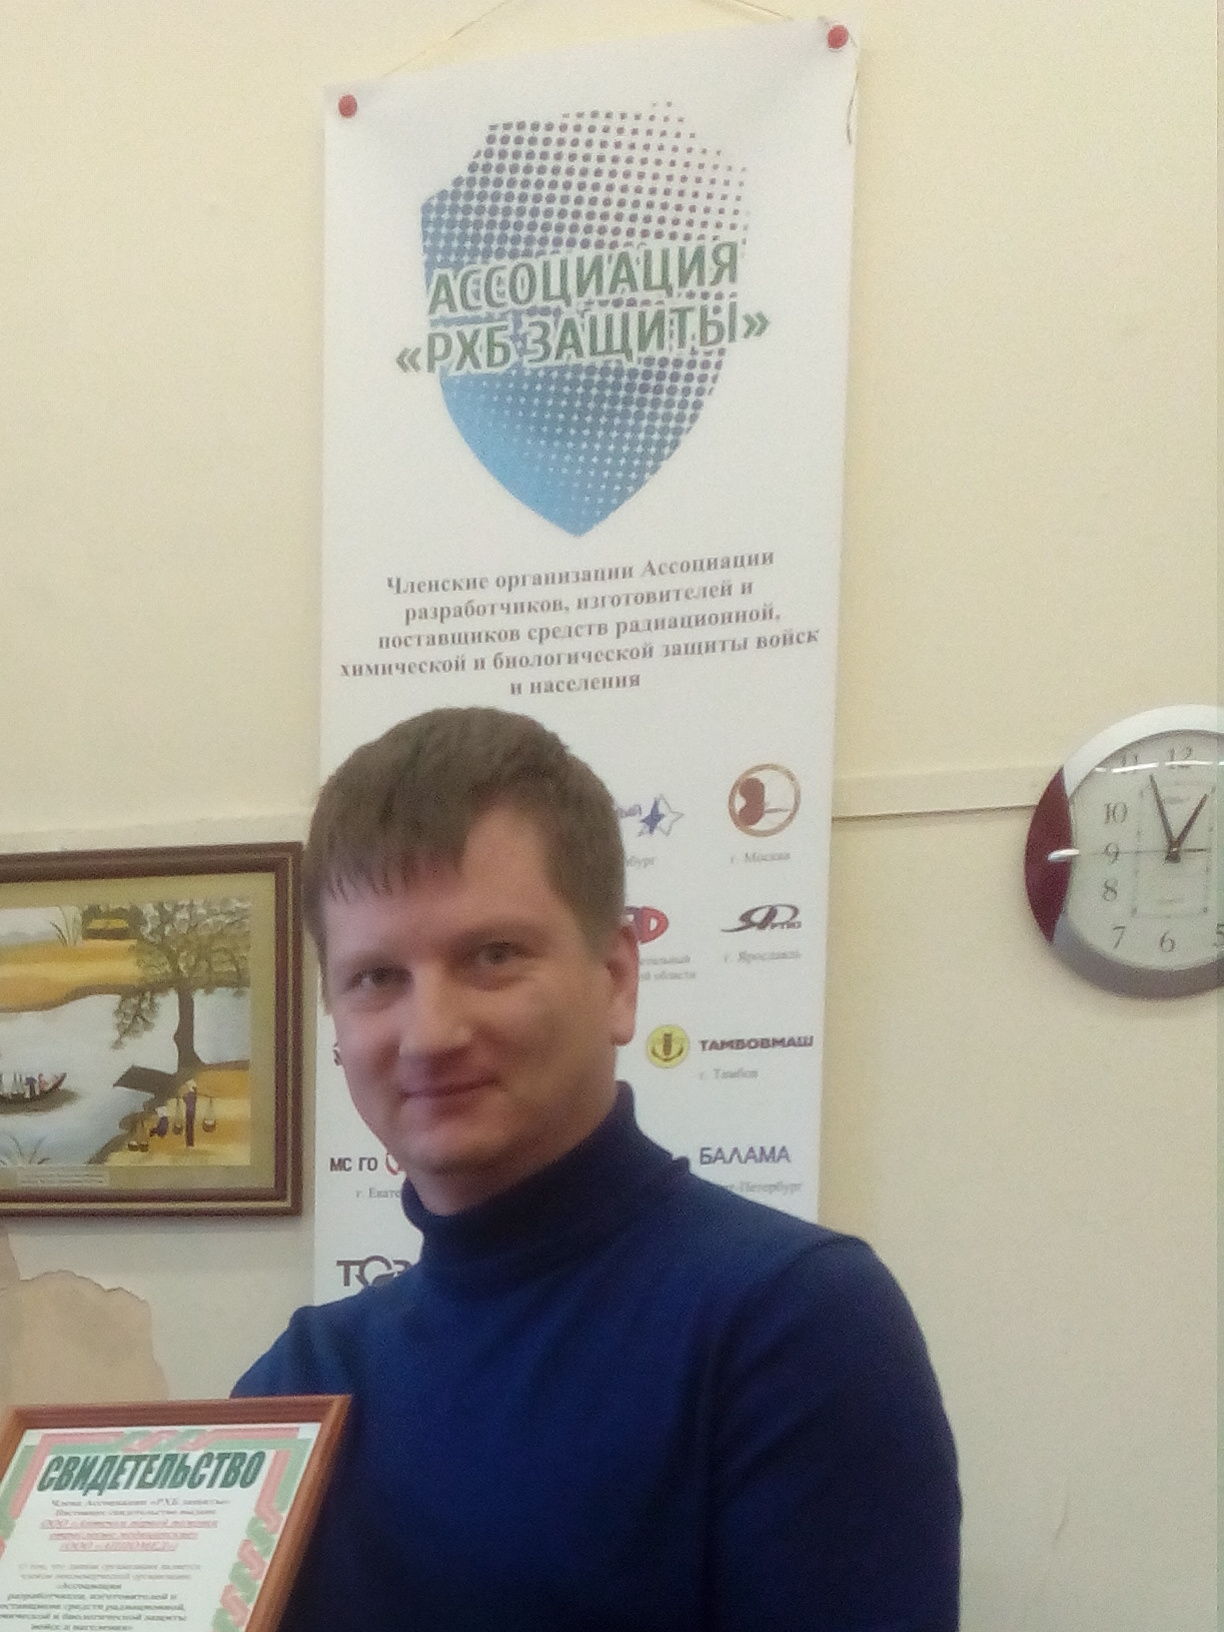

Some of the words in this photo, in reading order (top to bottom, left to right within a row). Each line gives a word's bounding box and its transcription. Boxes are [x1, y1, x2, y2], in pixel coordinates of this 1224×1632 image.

[428, 241, 739, 315] АССОЦИАЦИЯ
[396, 324, 512, 374] «РХБ
[524, 301, 770, 365] ЗАЩИТЫ»
[387, 575, 489, 595] Членские
[495, 565, 635, 592] организации
[641, 551, 774, 578] Ассоциации
[405, 598, 570, 626] разработчиков,
[577, 579, 733, 611] изготовителей
[740, 581, 754, 596] и
[378, 627, 522, 650] поставщиков
[527, 621, 609, 645] средств
[616, 601, 782, 639] радиационной,
[340, 654, 467, 678] химической
[473, 657, 487, 672] и
[492, 642, 654, 670] биологической
[662, 637, 749, 657] защиты
[756, 627, 821, 650] войск
[509, 681, 523, 696] и
[529, 672, 641, 695] населения
[1104, 803, 1128, 824] 10
[1103, 842, 1120, 865] 9
[1102, 879, 1119, 902] 8
[1112, 926, 1127, 949] 7
[1160, 931, 1176, 953] 6
[329, 1157, 352, 1172] МС
[358, 1156, 379, 1172] ГО
[699, 1146, 792, 1166] БАЛАМА
[37, 1451, 266, 1497] СВИДЕТЕЛЬСТВО
